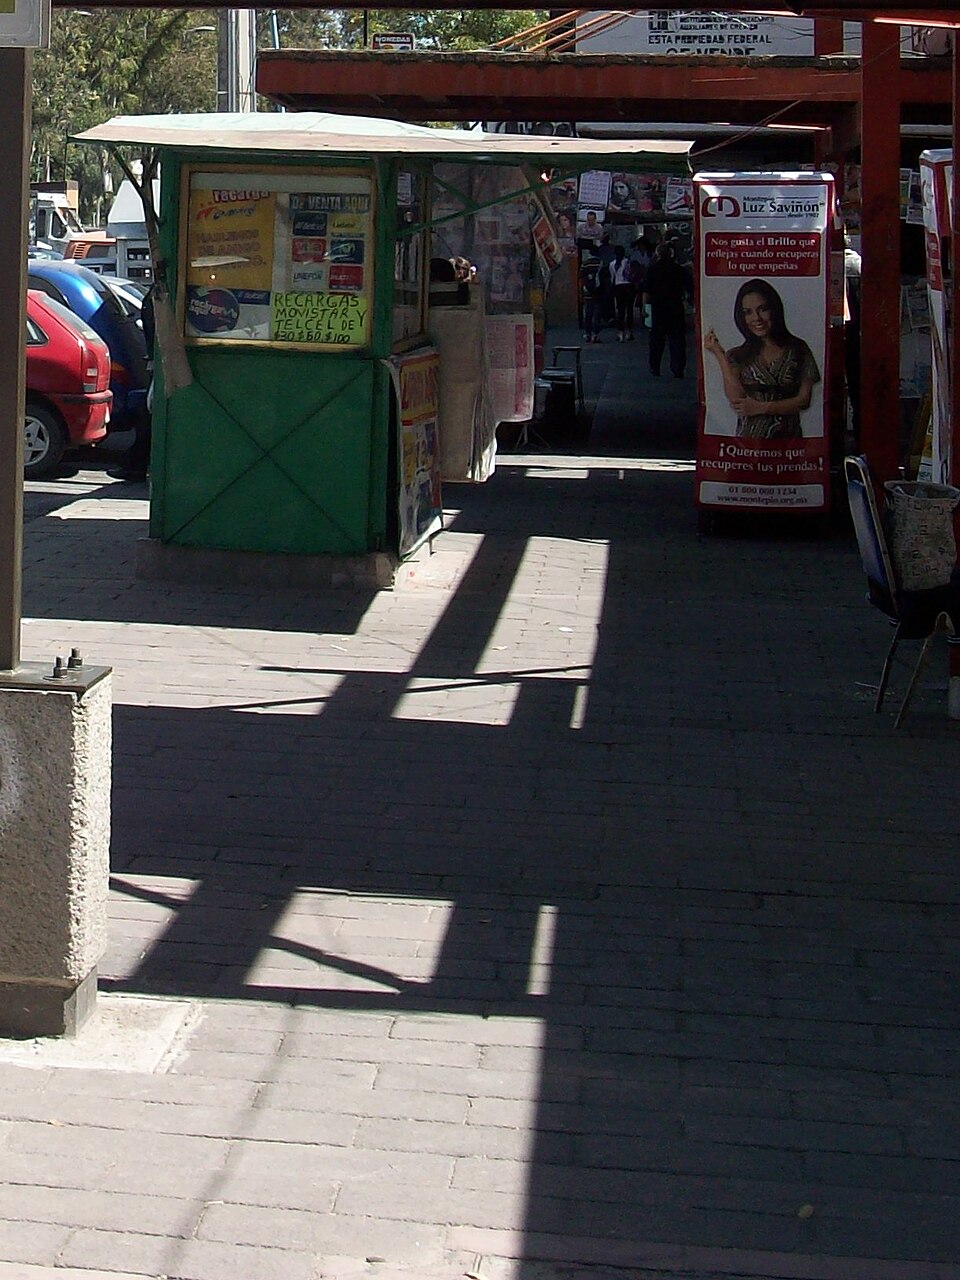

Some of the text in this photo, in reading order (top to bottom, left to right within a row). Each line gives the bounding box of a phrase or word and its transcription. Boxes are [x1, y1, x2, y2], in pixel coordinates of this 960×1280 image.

[649, 35, 673, 44] ESTA
[727, 35, 772, 44] FEDERAL
[308, 196, 341, 210] VENTA
[743, 200, 820, 213] Luz Saviñón
[711, 237, 816, 248] Nos gusta el Brillo que
[707, 249, 819, 260] reflejas cuando recuperas
[728, 261, 798, 272] lo que empeñas
[274, 292, 359, 308] RECARGAS
[275, 307, 368, 327] MOVISTAR Y
[274, 319, 355, 334] TELCEL DE
[719, 443, 805, 459] ¡Queremos que
[700, 457, 824, 474] recuperes tus prendas!
